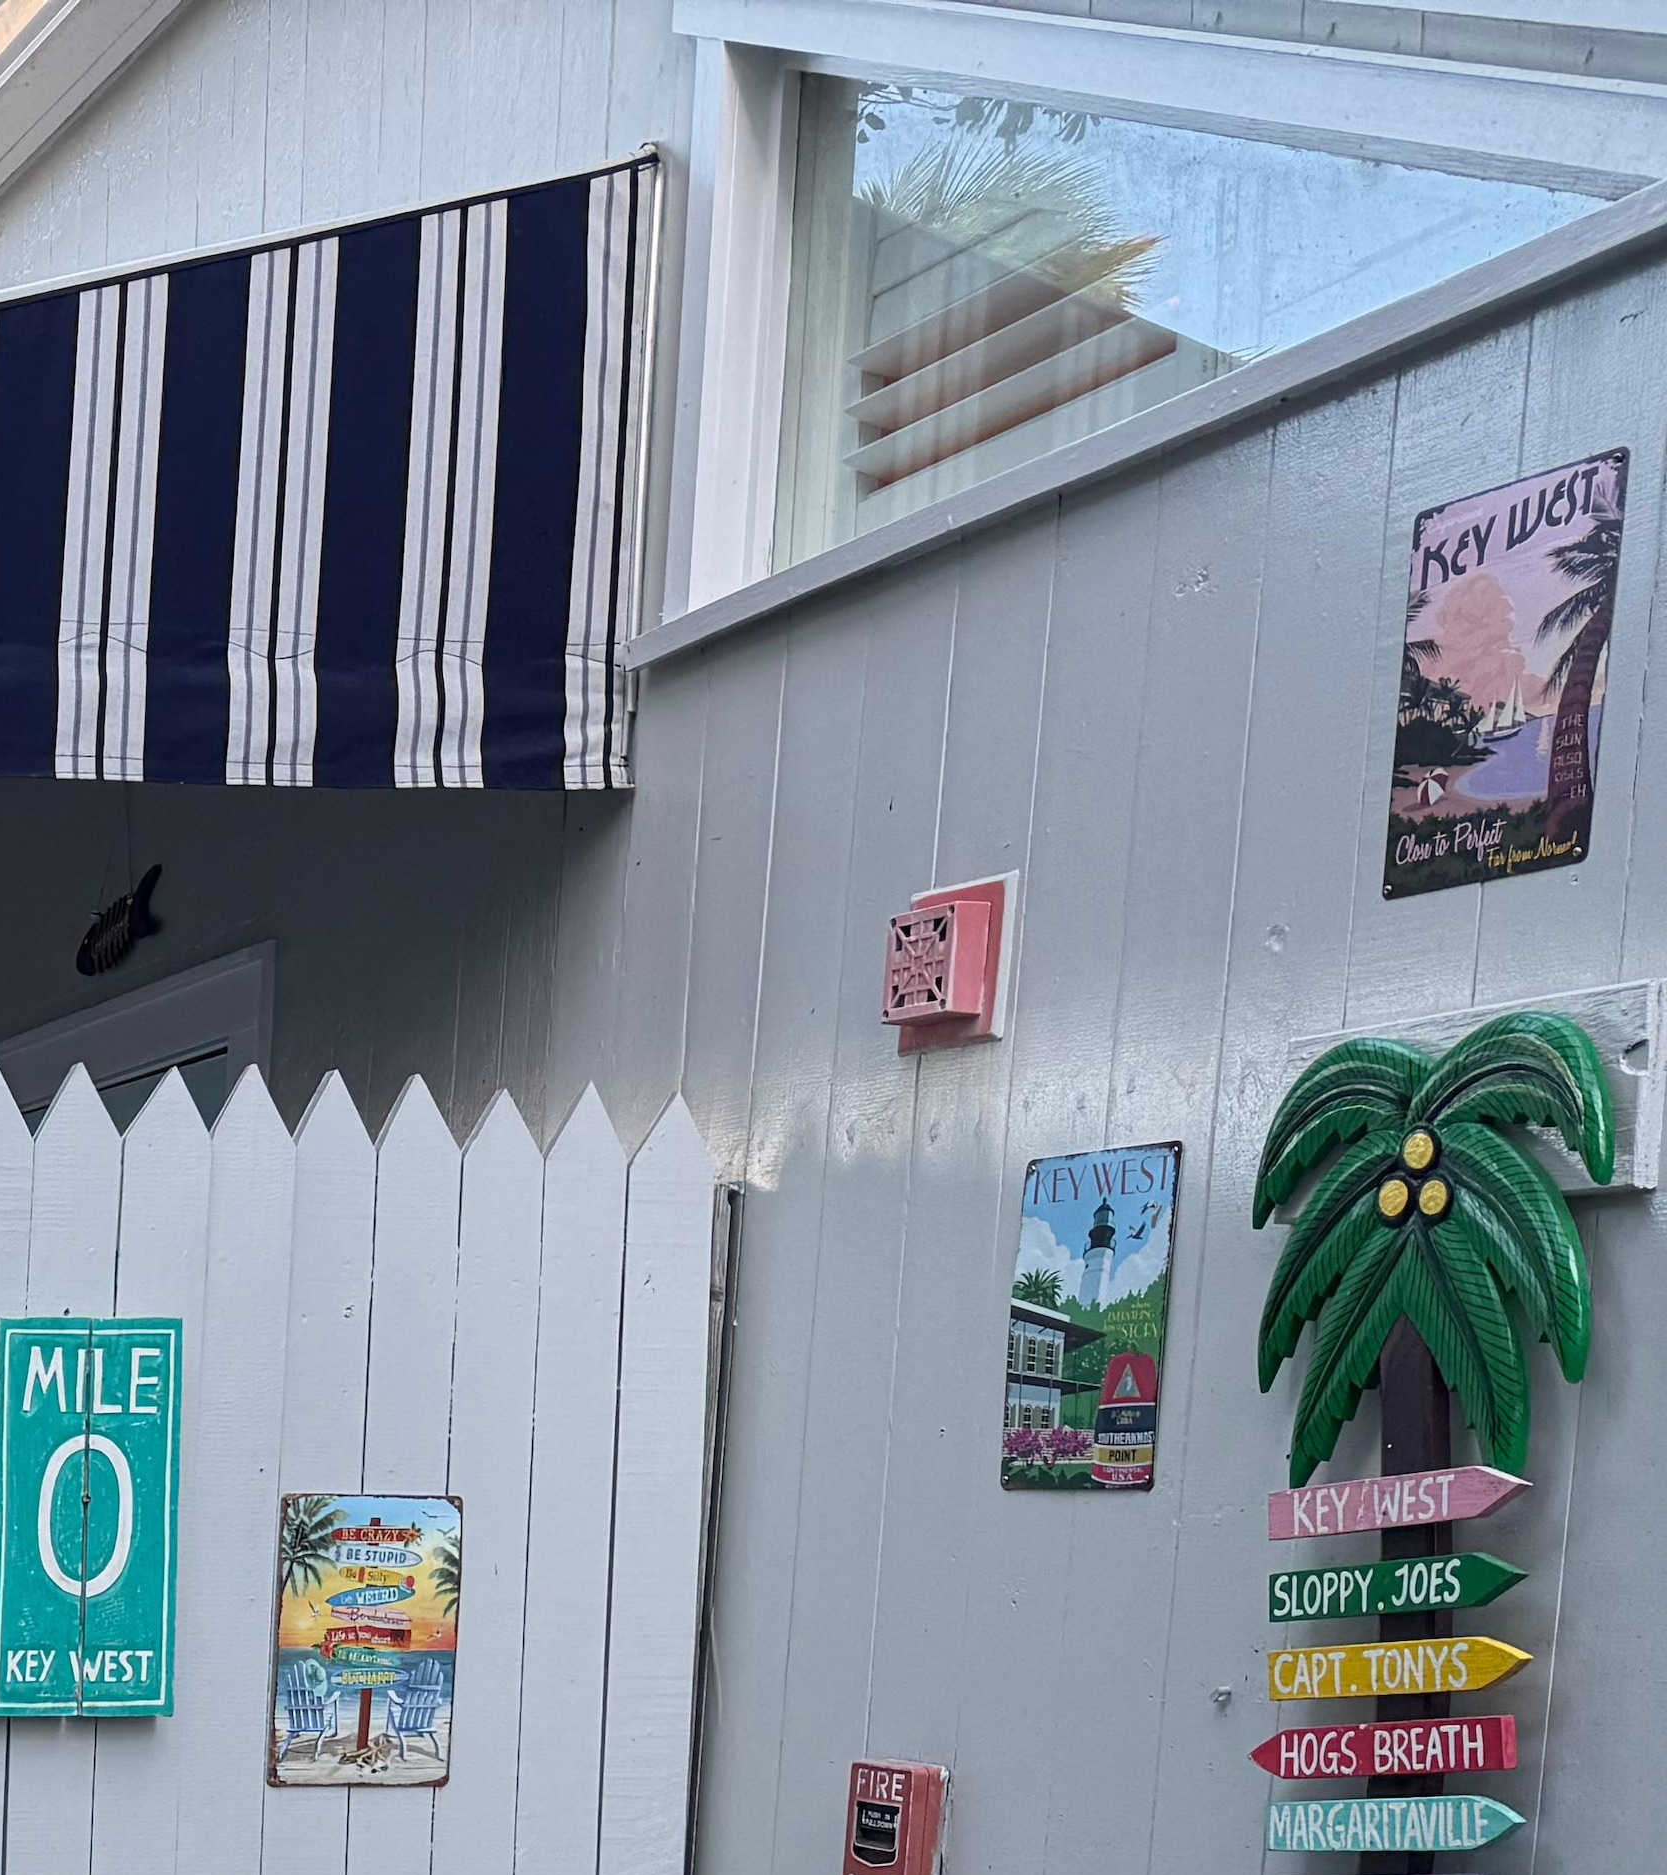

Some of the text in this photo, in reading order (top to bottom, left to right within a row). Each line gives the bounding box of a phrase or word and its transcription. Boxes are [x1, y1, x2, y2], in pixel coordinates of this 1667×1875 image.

[1420, 466, 1600, 591] KEY WEST
[1556, 732, 1583, 751] SUN
[1562, 713, 1585, 730] THE
[1395, 819, 1507, 865] Close to Perfect
[1487, 846, 1506, 868] Far
[1033, 1155, 1171, 1205] KEY WEST
[22, 1346, 161, 1414] MILE
[1108, 1449, 1137, 1462] POINT
[38, 1434, 134, 1598] 0
[1293, 1474, 1455, 1536] KEY WEST
[341, 1529, 399, 1541] BE CRAZY
[346, 1549, 407, 1564] BE STUPID
[1391, 1558, 1462, 1606] JOES
[6, 1650, 154, 1683] KEY WEST
[1274, 1642, 1469, 1697] CAPT. TONYS
[1280, 1724, 1485, 1777] HOGS BREATH
[856, 1768, 906, 1802] FIRE
[1269, 1801, 1489, 1851] MARGARITAVILLE
